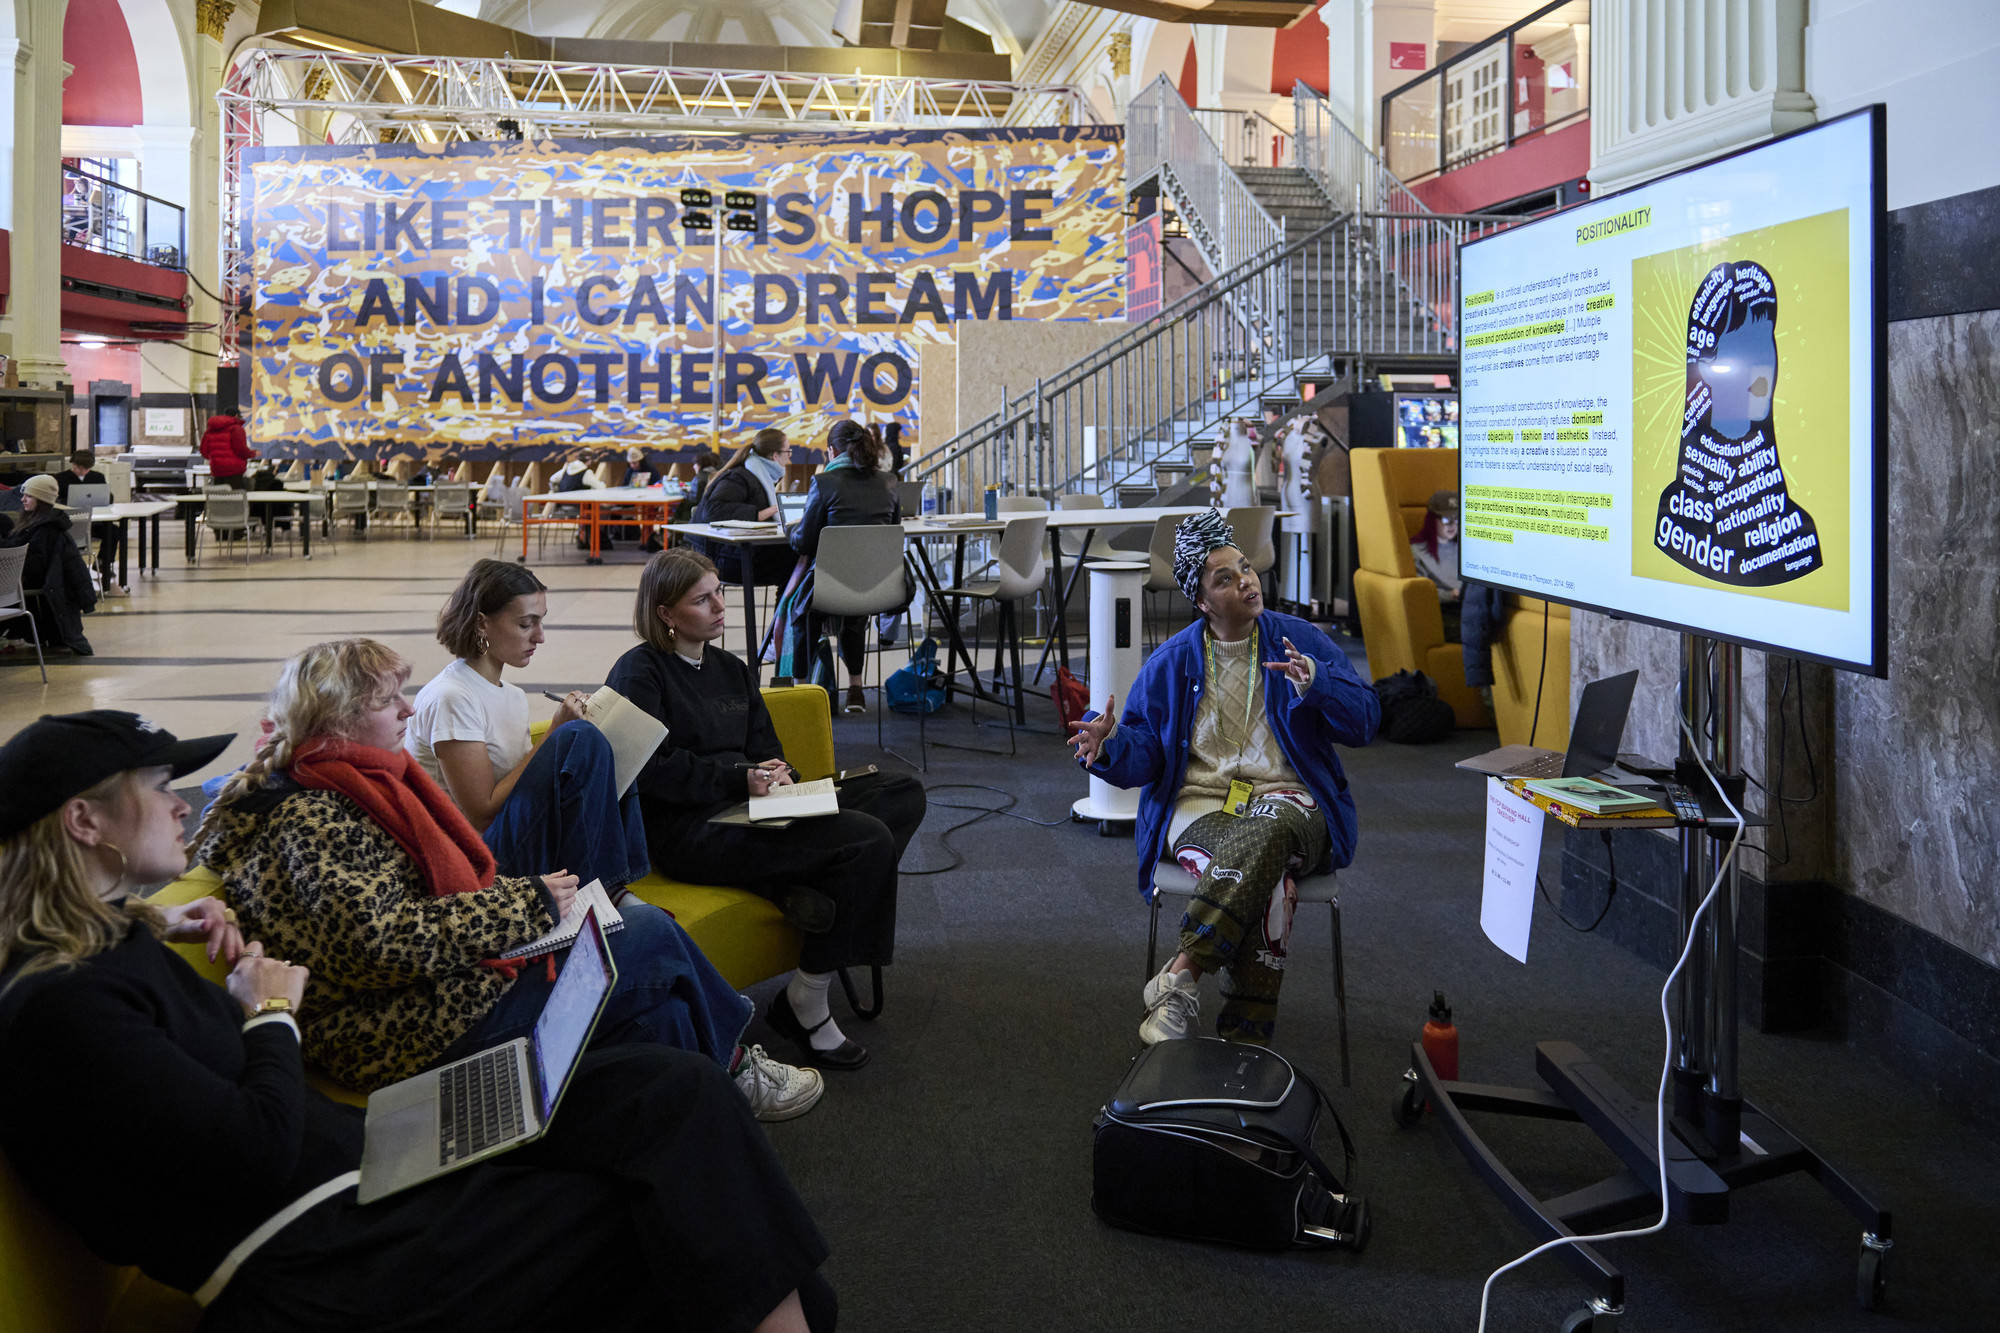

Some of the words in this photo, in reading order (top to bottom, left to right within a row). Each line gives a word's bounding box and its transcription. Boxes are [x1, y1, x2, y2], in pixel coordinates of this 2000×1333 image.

[326, 200, 468, 251] LIKE
[754, 191, 816, 245] IS
[849, 189, 1053, 244] HOPE
[1577, 207, 1651, 243] POSITIONALITY
[1505, 284, 1521, 297] critical
[1522, 276, 1560, 293] understanding
[1562, 273, 1568, 283] of
[1569, 271, 1578, 282] the
[1580, 268, 1592, 279] role
[1594, 268, 1598, 276] a
[1692, 266, 1725, 320] ethnicity
[1735, 265, 1771, 292] heritage
[355, 276, 498, 326] AND
[531, 276, 544, 325] I
[577, 274, 714, 325] CAN
[753, 271, 1012, 325] DREAM
[1488, 300, 1516, 315] background
[1518, 298, 1527, 308] and
[1529, 293, 1548, 306] current
[1574, 279, 1609, 297] constructed
[1700, 278, 1733, 326] language
[1499, 316, 1517, 329] position
[1519, 314, 1523, 323] in
[1525, 312, 1533, 322] the
[1535, 308, 1549, 320] world
[1551, 307, 1566, 320] plays
[1568, 304, 1572, 314] in
[1574, 302, 1584, 312] the
[1586, 297, 1612, 310] creative
[1495, 329, 1523, 344] production
[1525, 327, 1531, 336] of
[1532, 322, 1564, 335] knowledge
[1577, 315, 1600, 329] Multiple
[1517, 343, 1522, 352] of
[1523, 340, 1545, 352] knowing
[1546, 340, 1552, 348] or
[1554, 333, 1595, 347] understanding
[1598, 330, 1607, 341] the
[1689, 326, 1715, 348] age
[1500, 359, 1524, 369] creatives
[1525, 357, 1540, 366] come
[1541, 355, 1554, 364] from
[1555, 351, 1572, 362] varied
[1574, 349, 1599, 361] vantage
[319, 353, 404, 402] OF
[428, 352, 768, 405] ANOTHER
[794, 351, 912, 406] WO
[1496, 402, 1516, 415] positivist
[1518, 401, 1552, 411] constructions
[1554, 399, 1560, 409] of
[1597, 397, 1607, 407] the
[1681, 417, 1697, 438] family
[1696, 397, 1712, 420] status
[1684, 386, 1709, 421] culture
[1488, 417, 1510, 426] construct
[1511, 417, 1516, 426] of
[1518, 416, 1548, 428] positionality
[1550, 415, 1570, 424] refutes
[1572, 413, 1602, 424] dominant
[1488, 432, 1513, 443] objectivity
[1515, 431, 1519, 440] in
[1521, 431, 1541, 440] fashion
[1543, 431, 1554, 440] and
[1700, 434, 1741, 457] education
[1742, 429, 1765, 454] level
[1485, 460, 1500, 469] fosters
[1506, 461, 1525, 472] specific
[1526, 461, 1565, 474] understanding
[1566, 462, 1572, 471] of
[1574, 462, 1591, 472] social
[1500, 446, 1508, 455] the
[1510, 448, 1519, 457] way
[1526, 446, 1548, 455] creative
[1550, 446, 1554, 455] is
[1556, 446, 1579, 456] situated
[1581, 446, 1586, 456] in
[1588, 448, 1607, 459] space
[1685, 445, 1736, 484] sexuality
[1738, 445, 1776, 477] ability
[1682, 463, 1704, 481] ethnicity
[1683, 475, 1705, 493] heritage
[1492, 489, 1513, 499] provides
[1519, 492, 1534, 502] space
[1535, 491, 1540, 500] to
[1542, 492, 1564, 505] critically
[1566, 493, 1598, 507] interrogate
[1600, 496, 1610, 506] the
[1707, 480, 1724, 494] age
[1715, 467, 1782, 510] occupation
[1481, 502, 1513, 513] practitioners
[1669, 489, 1714, 523] class
[1716, 492, 1785, 535] nationality
[1495, 517, 1504, 526] and
[1505, 518, 1528, 529] decisions
[1530, 521, 1535, 530] at
[1537, 523, 1550, 532] each
[1552, 524, 1562, 533] and
[1564, 527, 1579, 539] every
[1581, 527, 1598, 541] stage
[1600, 529, 1607, 539] of
[1744, 510, 1803, 548] religion
[1657, 515, 1735, 574] gender
[1739, 533, 1816, 574] documentation
[1784, 555, 1813, 572] language
